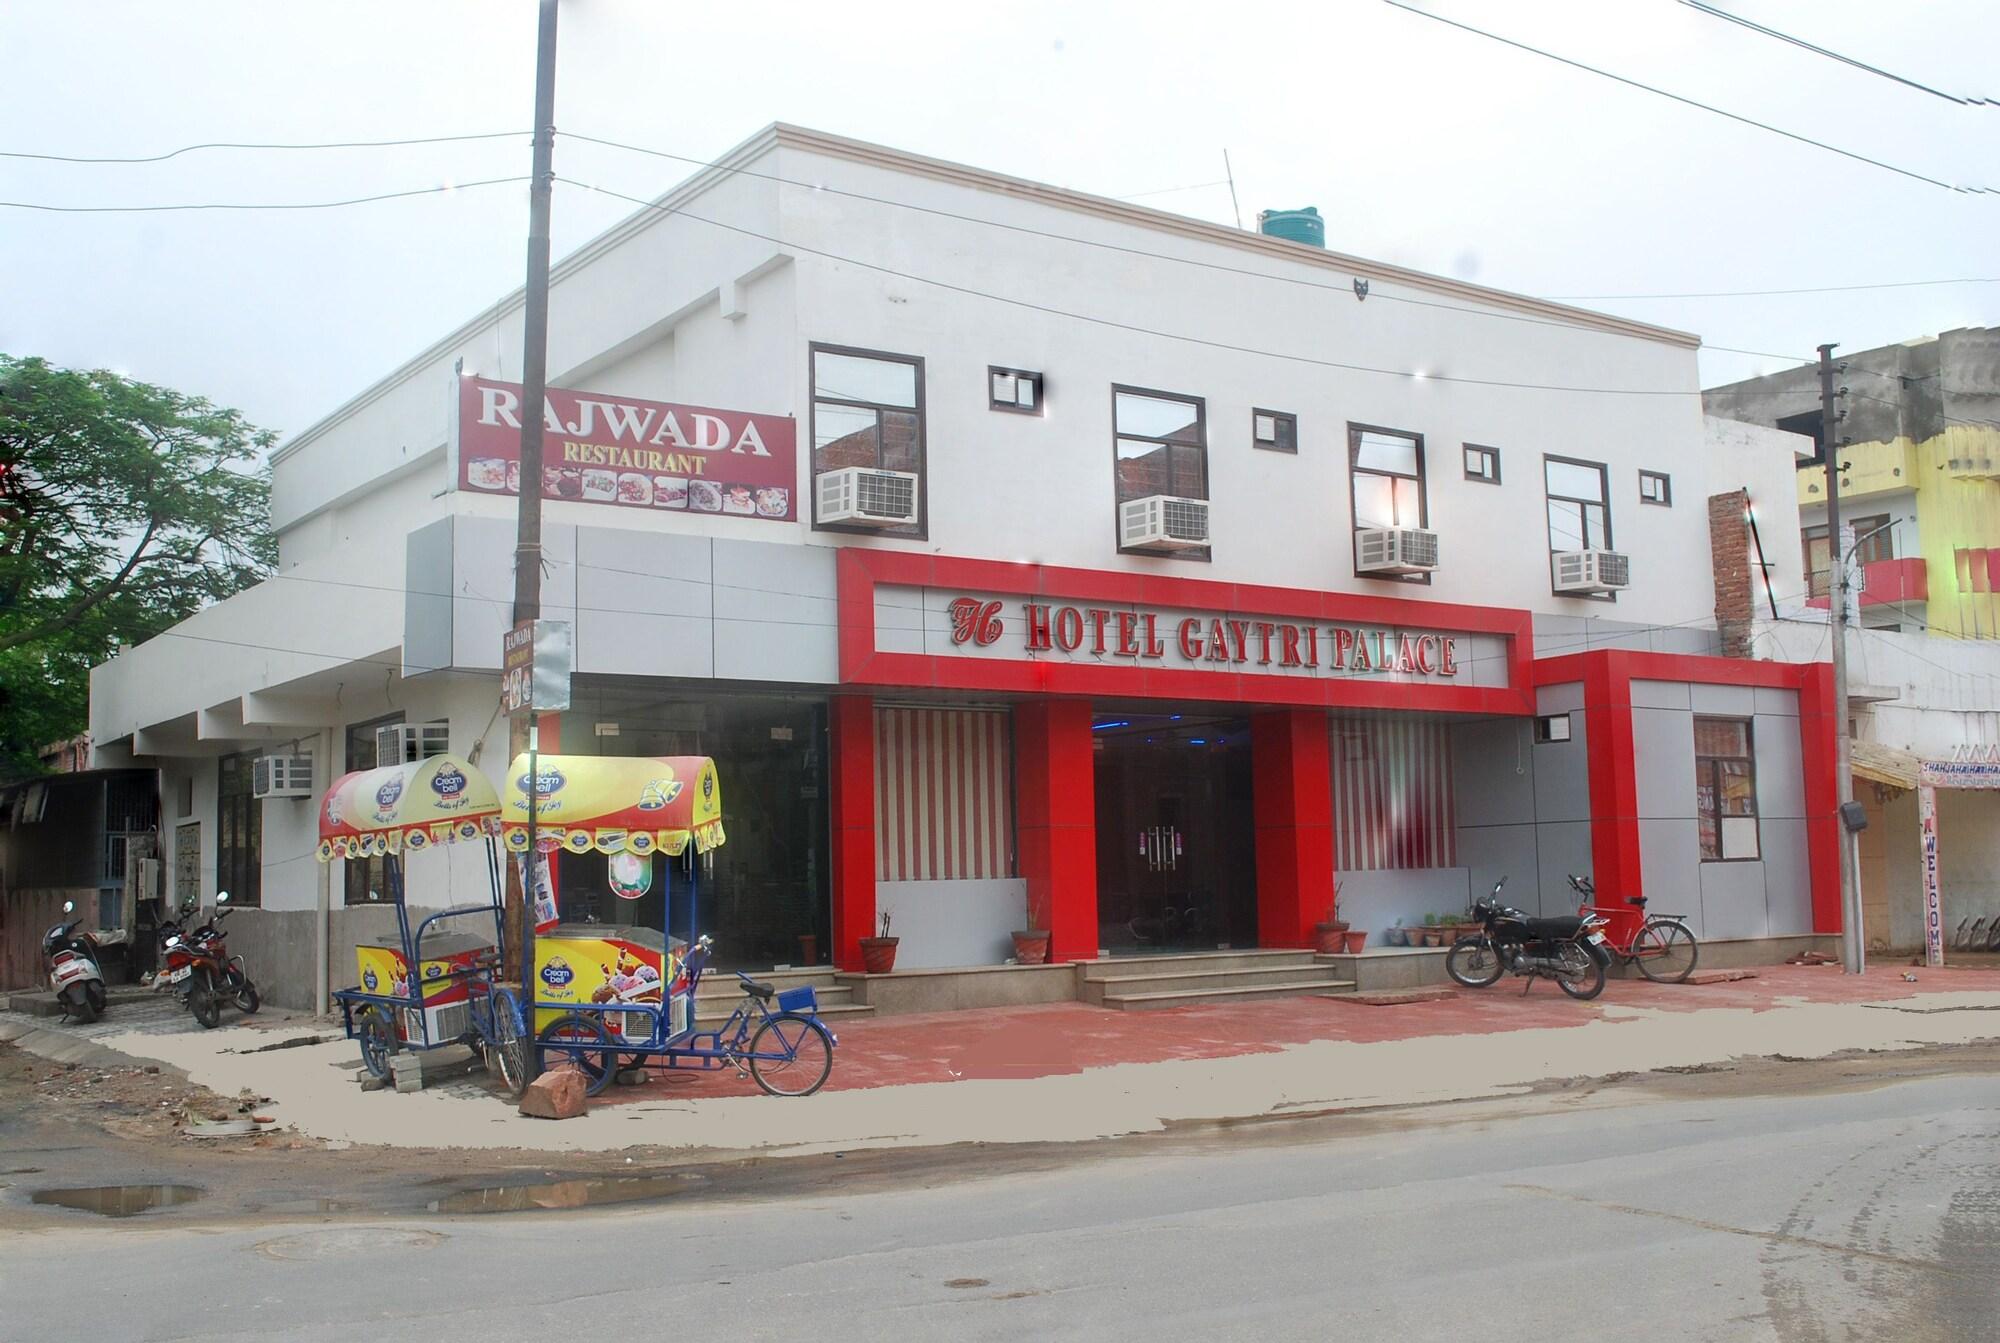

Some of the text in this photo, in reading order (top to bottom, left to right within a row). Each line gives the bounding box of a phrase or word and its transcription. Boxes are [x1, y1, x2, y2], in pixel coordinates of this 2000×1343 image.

[476, 386, 773, 457] RAJWADA
[563, 441, 708, 476] RESTAURANT
[1022, 602, 1165, 658] HOTEL
[1178, 617, 1321, 668] GAYTRI
[1329, 627, 1458, 677] PALACE
[435, 776, 462, 786] Cream
[1925, 836, 1940, 965] WELCOME
[543, 968, 570, 977] Cream
[549, 976, 565, 984] bell
